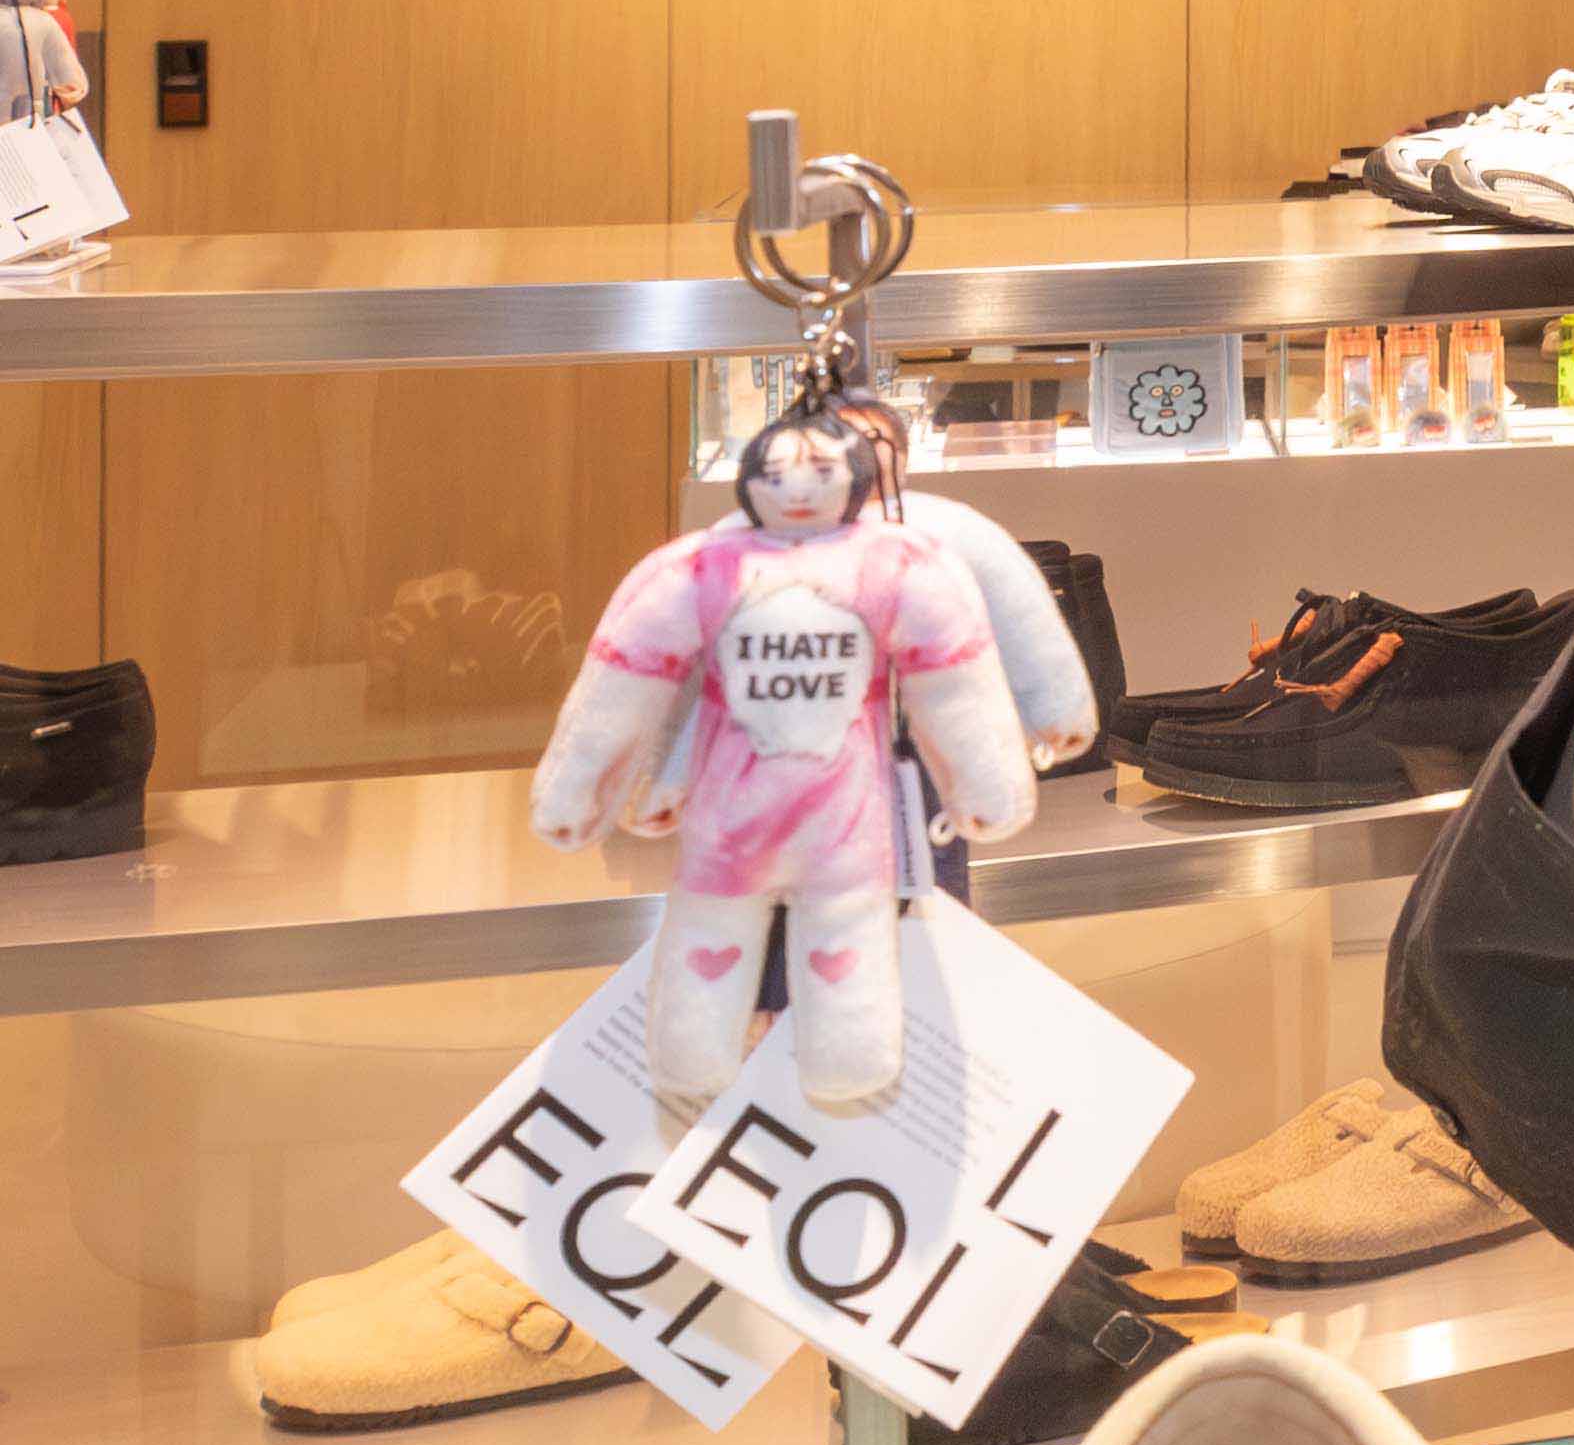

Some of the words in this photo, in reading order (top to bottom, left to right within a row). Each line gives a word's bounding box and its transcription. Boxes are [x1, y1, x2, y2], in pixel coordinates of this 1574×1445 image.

[737, 634, 752, 660] I
[761, 632, 859, 660] HATE
[747, 672, 846, 700] LOVE
[674, 1103, 967, 1385] EQL
